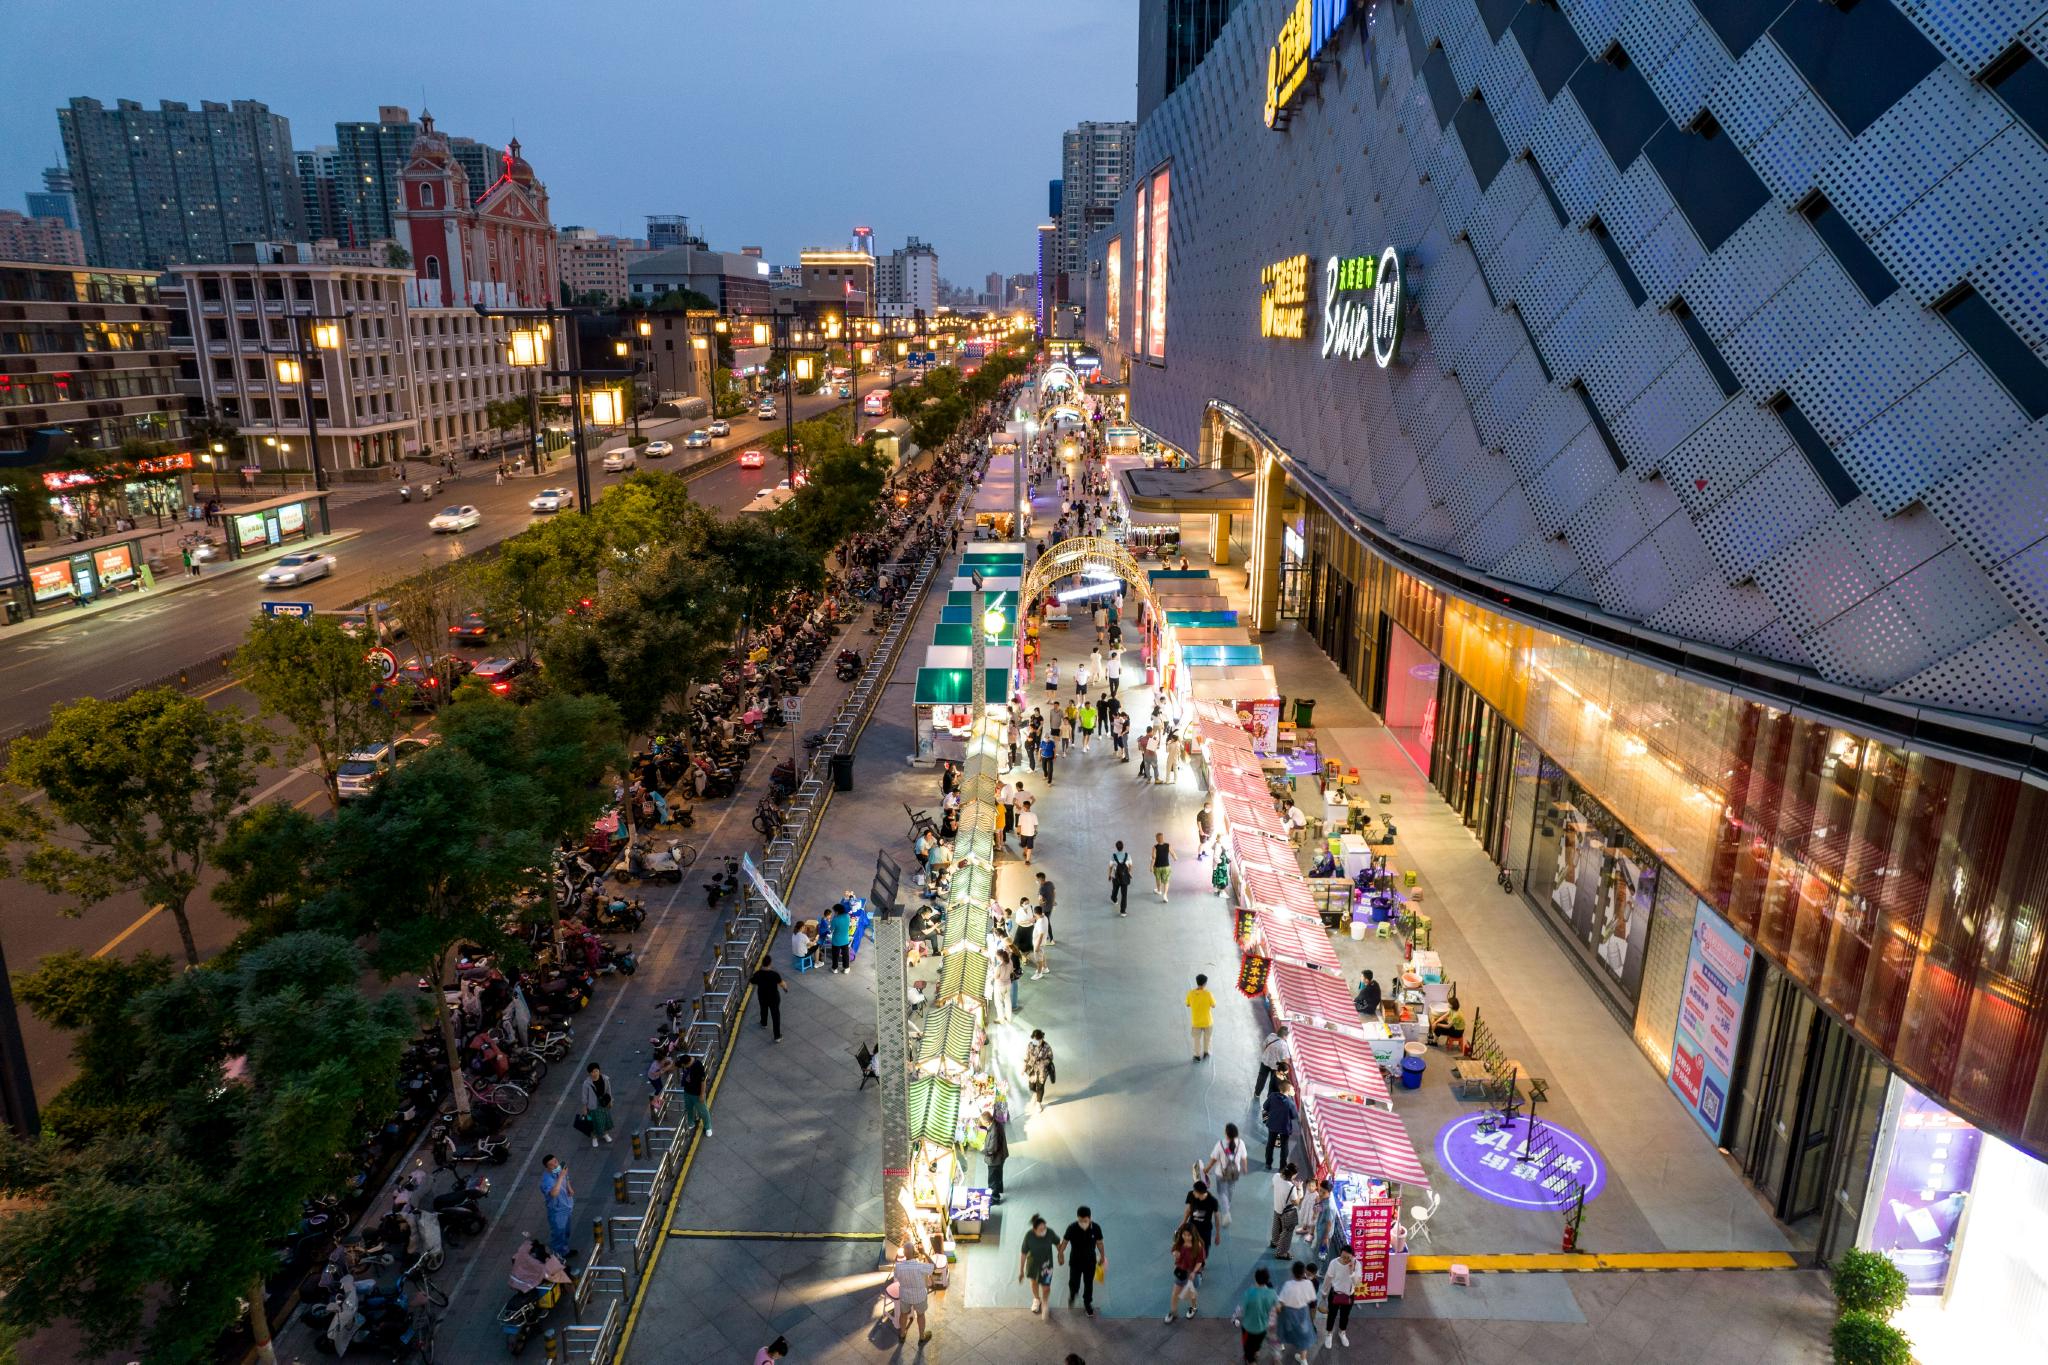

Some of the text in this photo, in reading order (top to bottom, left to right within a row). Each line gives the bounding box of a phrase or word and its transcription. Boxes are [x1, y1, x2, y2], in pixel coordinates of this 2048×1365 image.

[1339, 256, 1374, 290] 永辉超市
[1360, 1271, 1385, 1282] 用户
